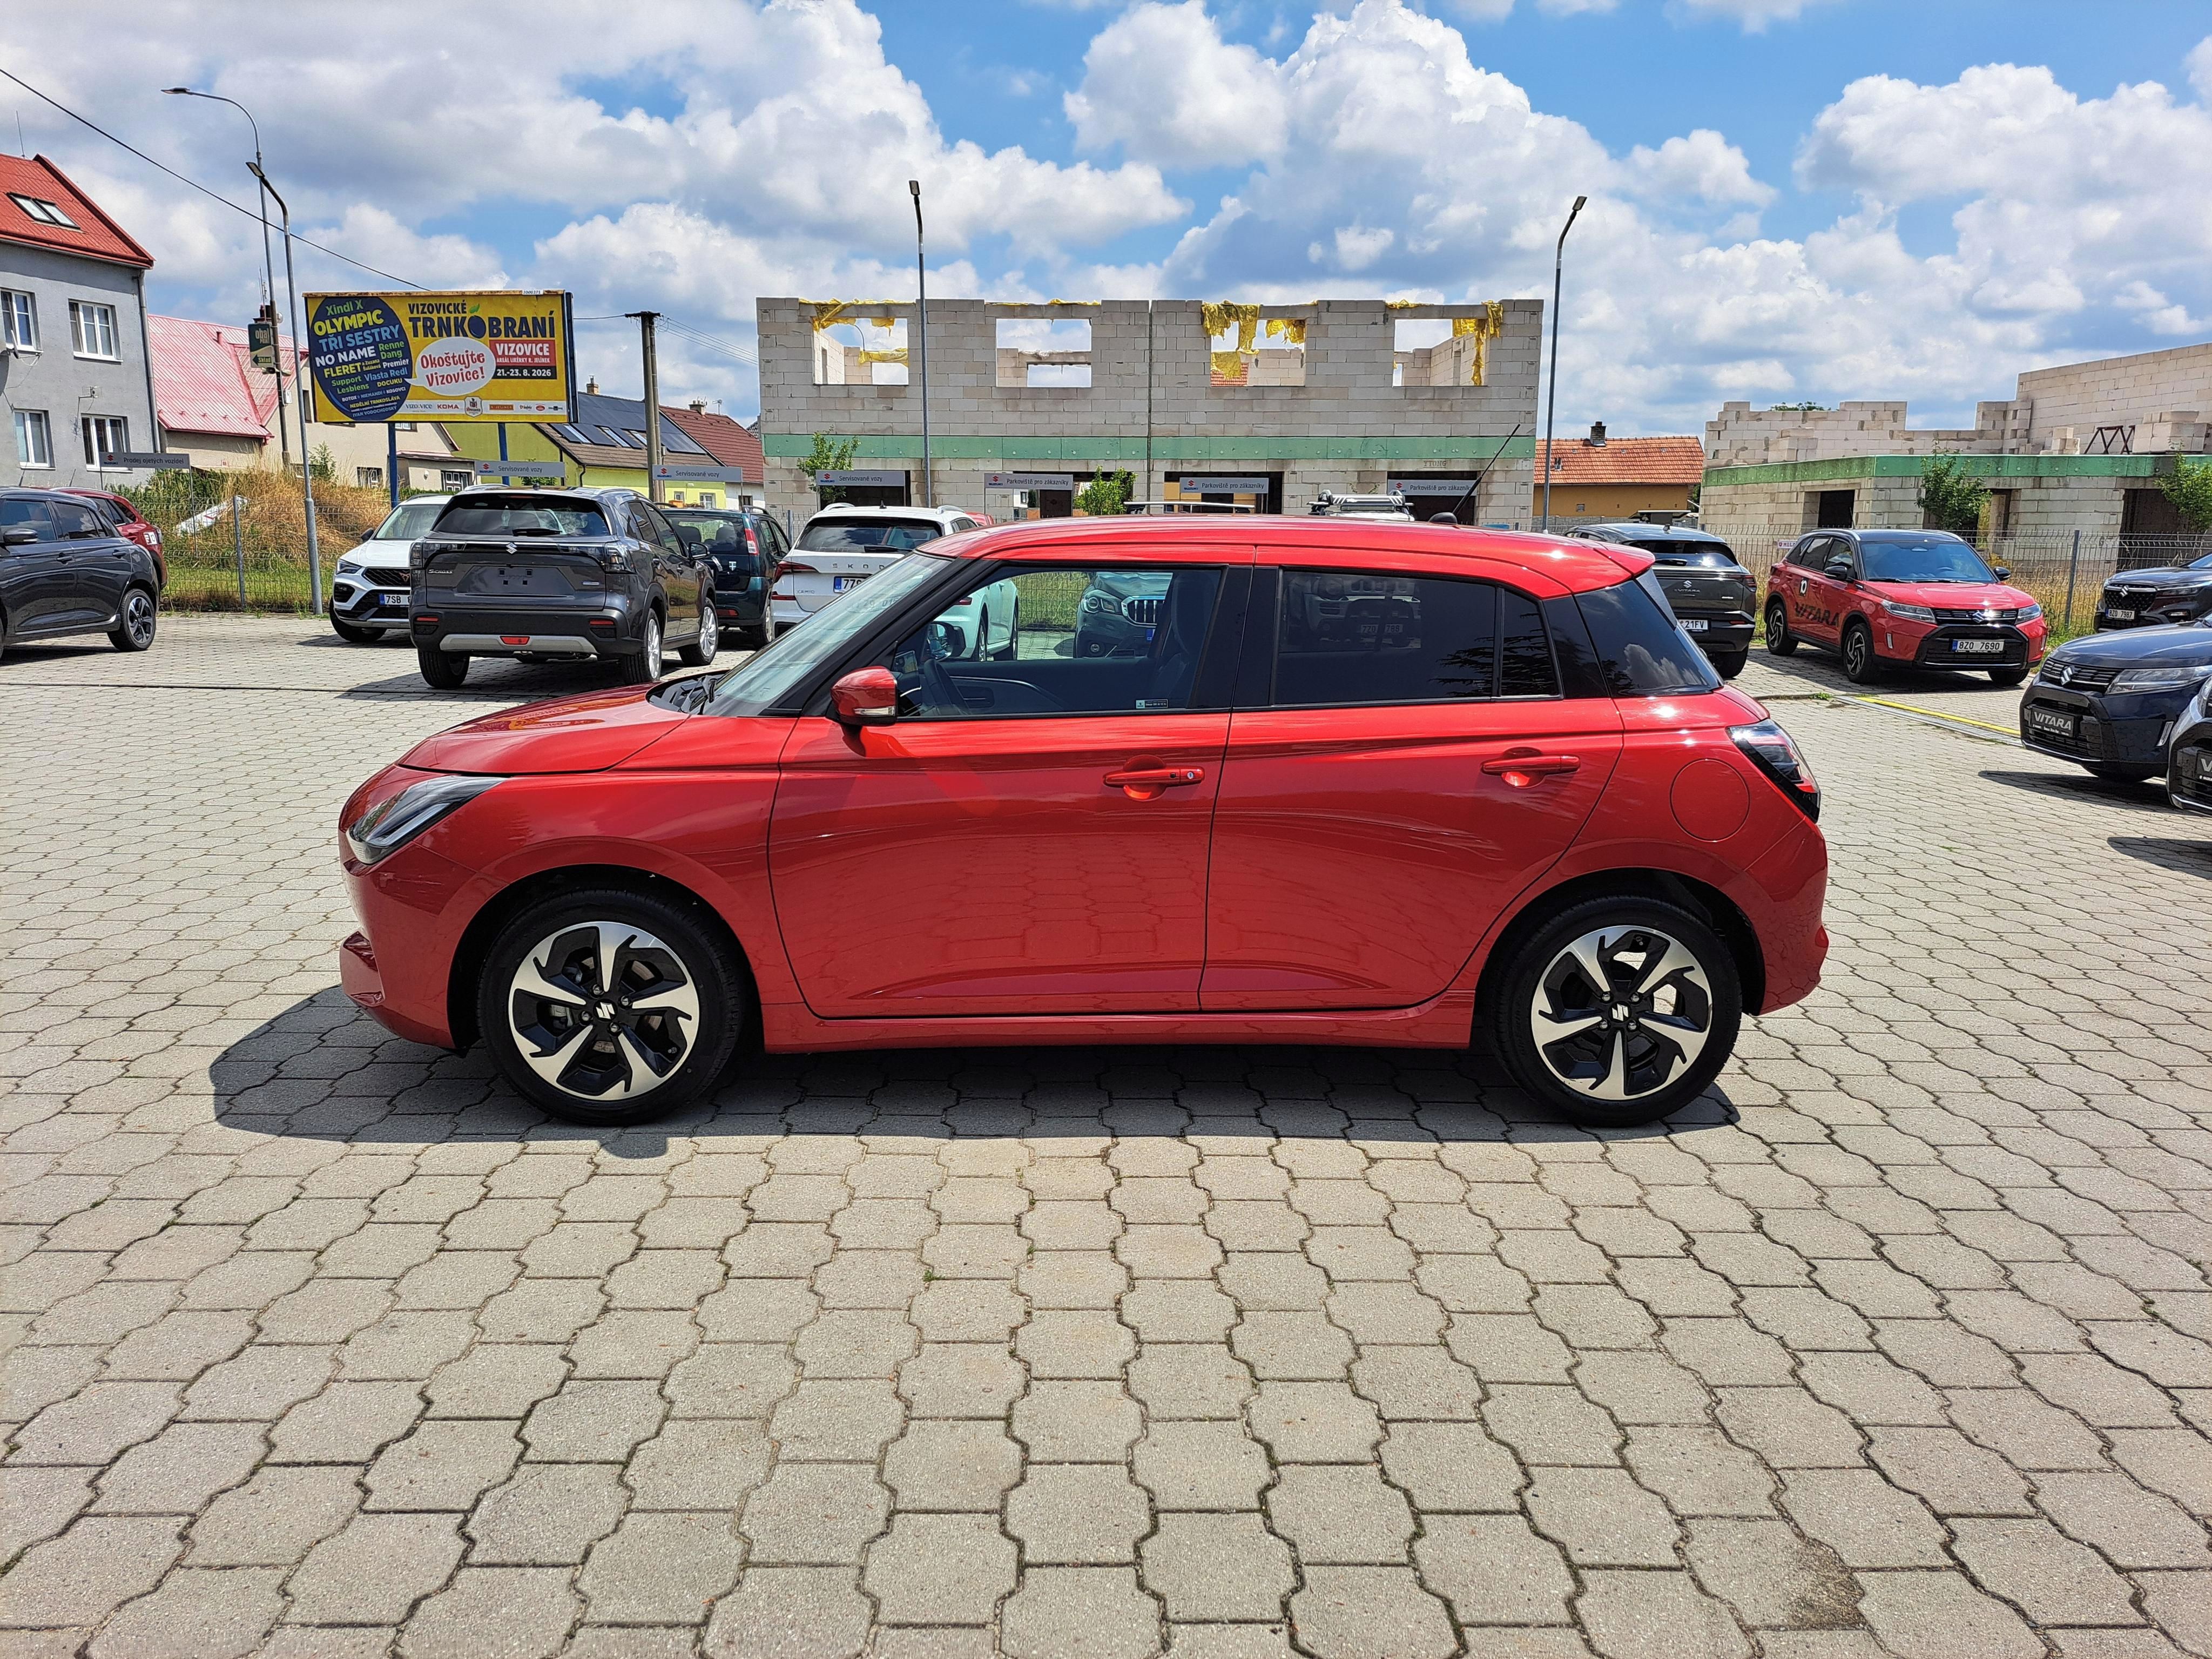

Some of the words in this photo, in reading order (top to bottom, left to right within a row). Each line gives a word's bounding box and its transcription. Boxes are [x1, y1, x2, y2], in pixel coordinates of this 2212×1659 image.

[325, 301, 353, 316] Xindl
[355, 299, 363, 309] X
[408, 300, 467, 314] VIZOVICKÉ
[314, 309, 384, 336] OLYMPIC
[319, 333, 343, 352] TŘI
[346, 324, 400, 347] SESTRY
[379, 341, 404, 351] Renne
[496, 343, 550, 355] VIZOVICE
[315, 354, 335, 367] NO
[338, 346, 376, 363] NAME
[380, 349, 403, 359] Dang
[420, 350, 485, 369] Okoštujte
[323, 362, 362, 378] FLERET
[383, 359, 409, 368] Premier
[332, 375, 362, 387] Support
[364, 372, 389, 381] Vlasta
[389, 367, 408, 377] Redl
[426, 366, 485, 387] Vizovice!
[337, 383, 369, 394] Lesbiens
[377, 378, 403, 387] DOCUKU
[386, 596, 401, 604] 7SB
[1795, 602, 1840, 626] VITARA
[1685, 621, 1704, 629] 21FV
[2034, 711, 2071, 730] VITARA
